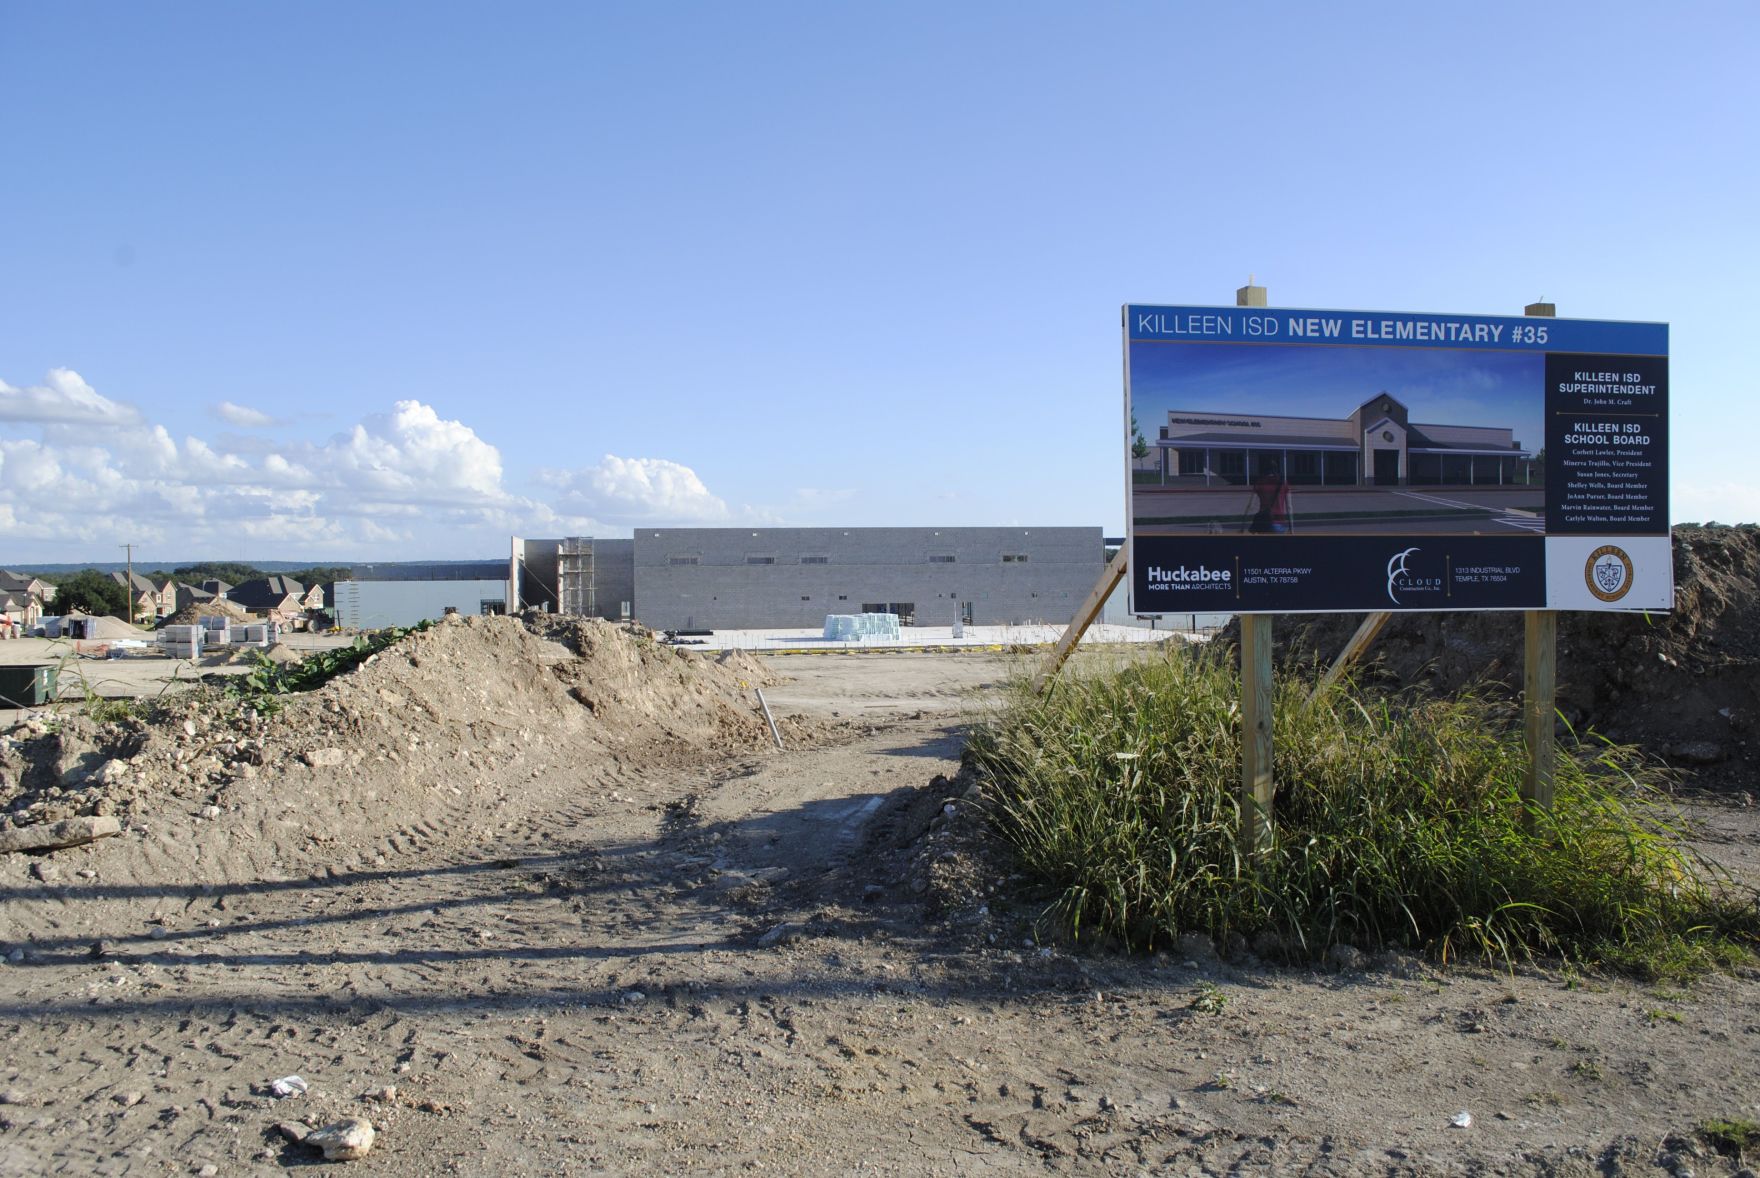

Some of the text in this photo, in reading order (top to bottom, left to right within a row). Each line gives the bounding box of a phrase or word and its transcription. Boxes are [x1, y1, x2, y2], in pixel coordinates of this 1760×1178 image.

[1138, 314, 1548, 345] KILLEEN ISD NEW ELEMENTARY #35
[1574, 371, 1641, 383] KILLEEN ISD
[1559, 382, 1656, 395] SUPERINTENDENT
[1574, 422, 1641, 433] KILLEEN ISD
[1564, 434, 1650, 445] SCHOOL BOARD
[1612, 471, 1638, 479] Secretary
[1567, 482, 1587, 490] Shelley
[1148, 565, 1232, 582] Huckabee
[1243, 576, 1269, 584] AUSTIN,
[1270, 576, 1278, 584] TX
[1399, 578, 1441, 586] CLOUD
